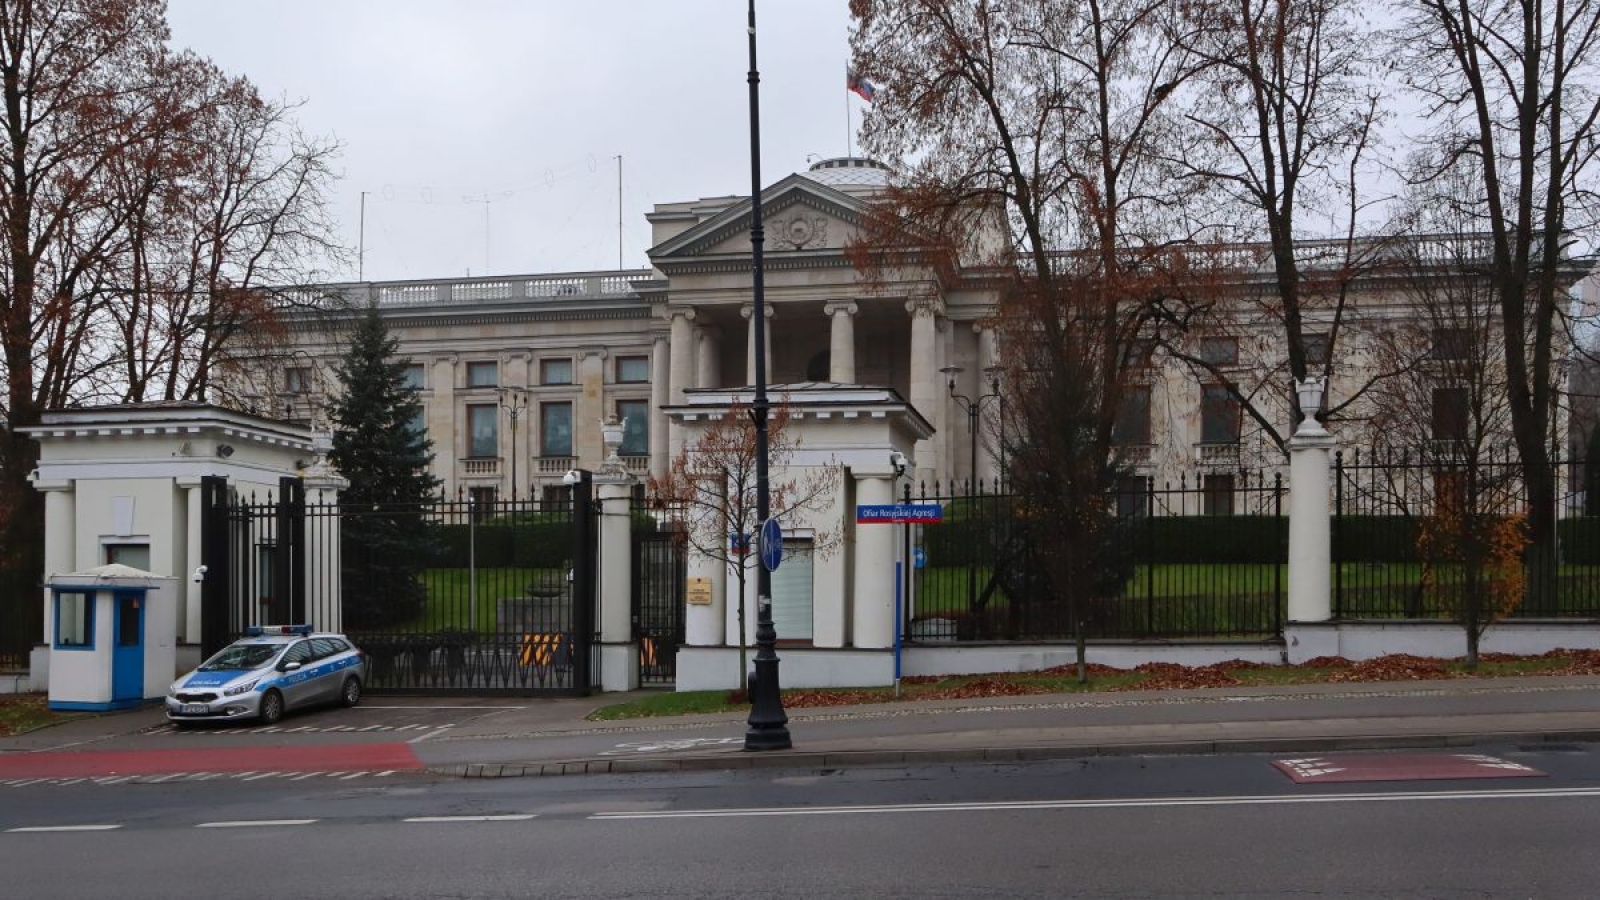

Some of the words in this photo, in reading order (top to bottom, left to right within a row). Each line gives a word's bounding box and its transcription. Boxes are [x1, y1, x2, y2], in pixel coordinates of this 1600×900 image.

[863, 508, 878, 517] Ofiar
[880, 508, 911, 519] Rosyjskiej
[912, 508, 935, 519] Agresji
